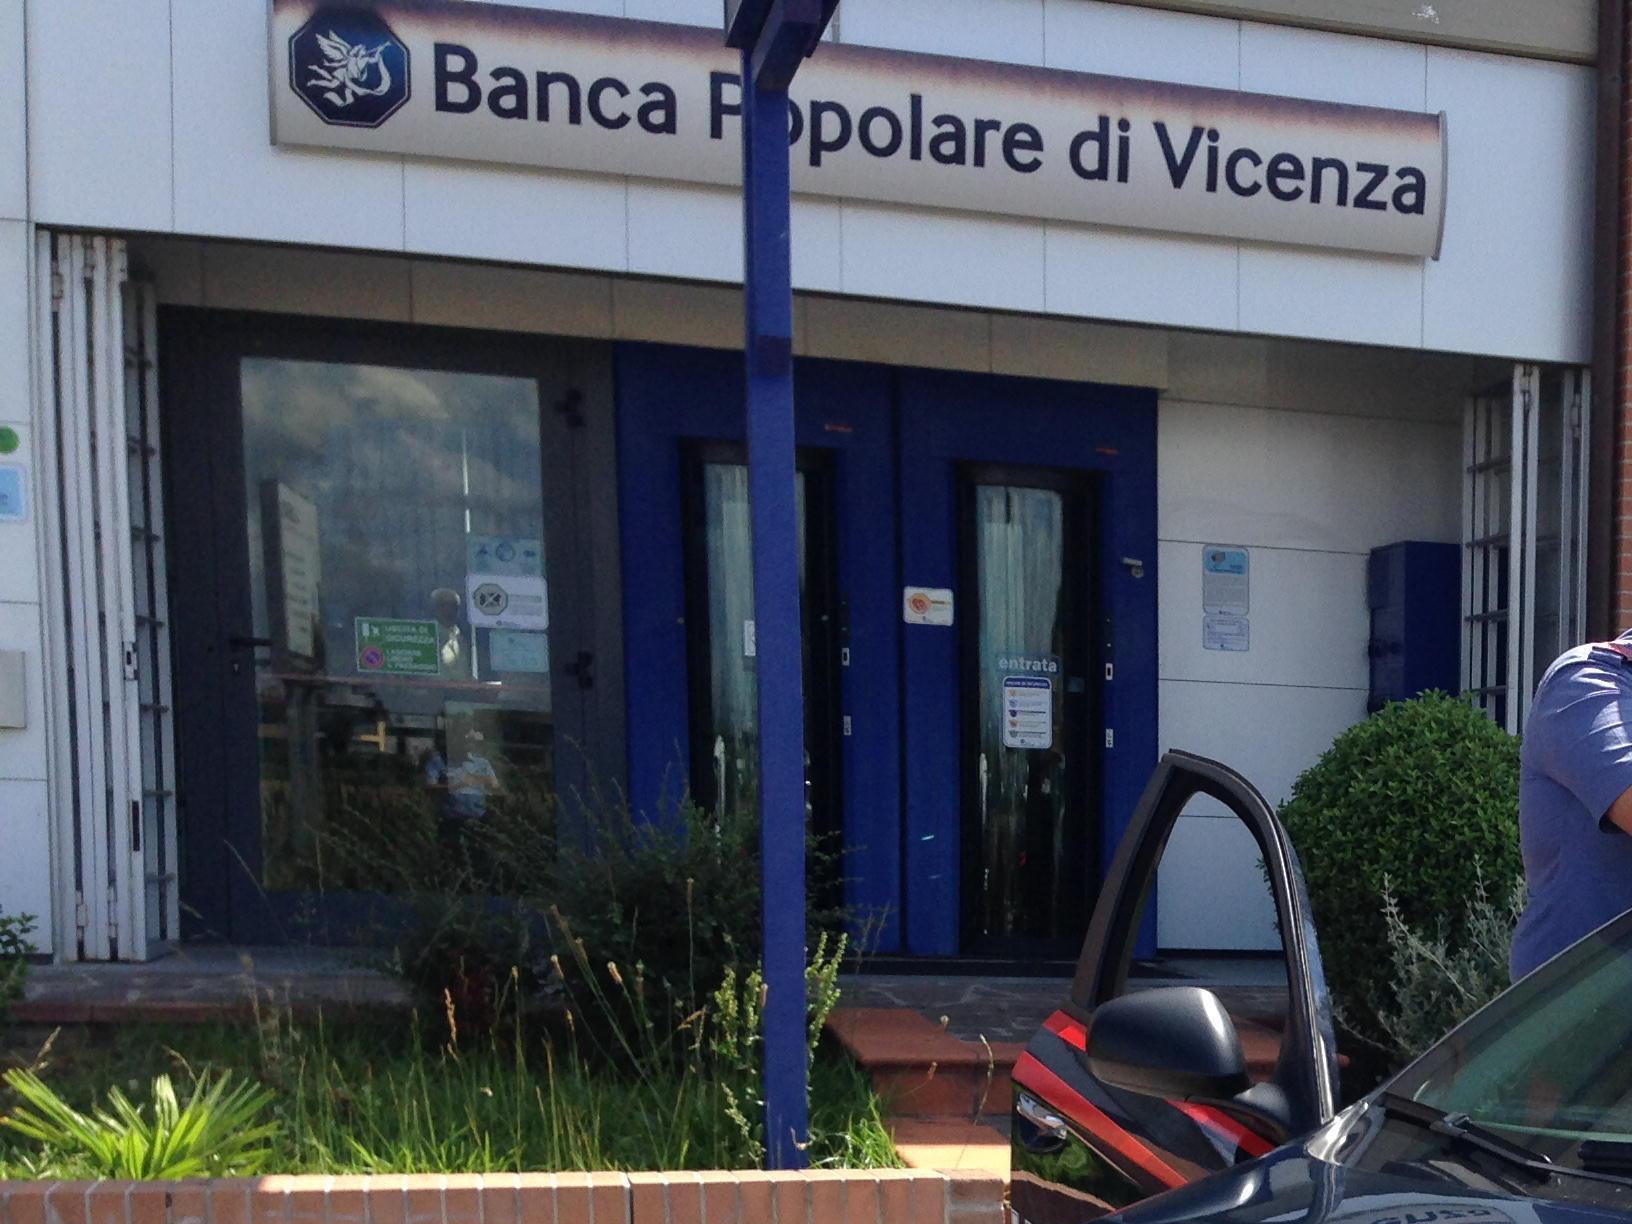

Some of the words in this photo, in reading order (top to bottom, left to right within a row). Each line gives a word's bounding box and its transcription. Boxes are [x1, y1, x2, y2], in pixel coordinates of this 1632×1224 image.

[432, 42, 678, 136] Banca
[711, 70, 1043, 174] Ppolare
[1069, 116, 1131, 184] di
[1153, 120, 1428, 216] Vicenza
[999, 656, 1058, 673] entrata
